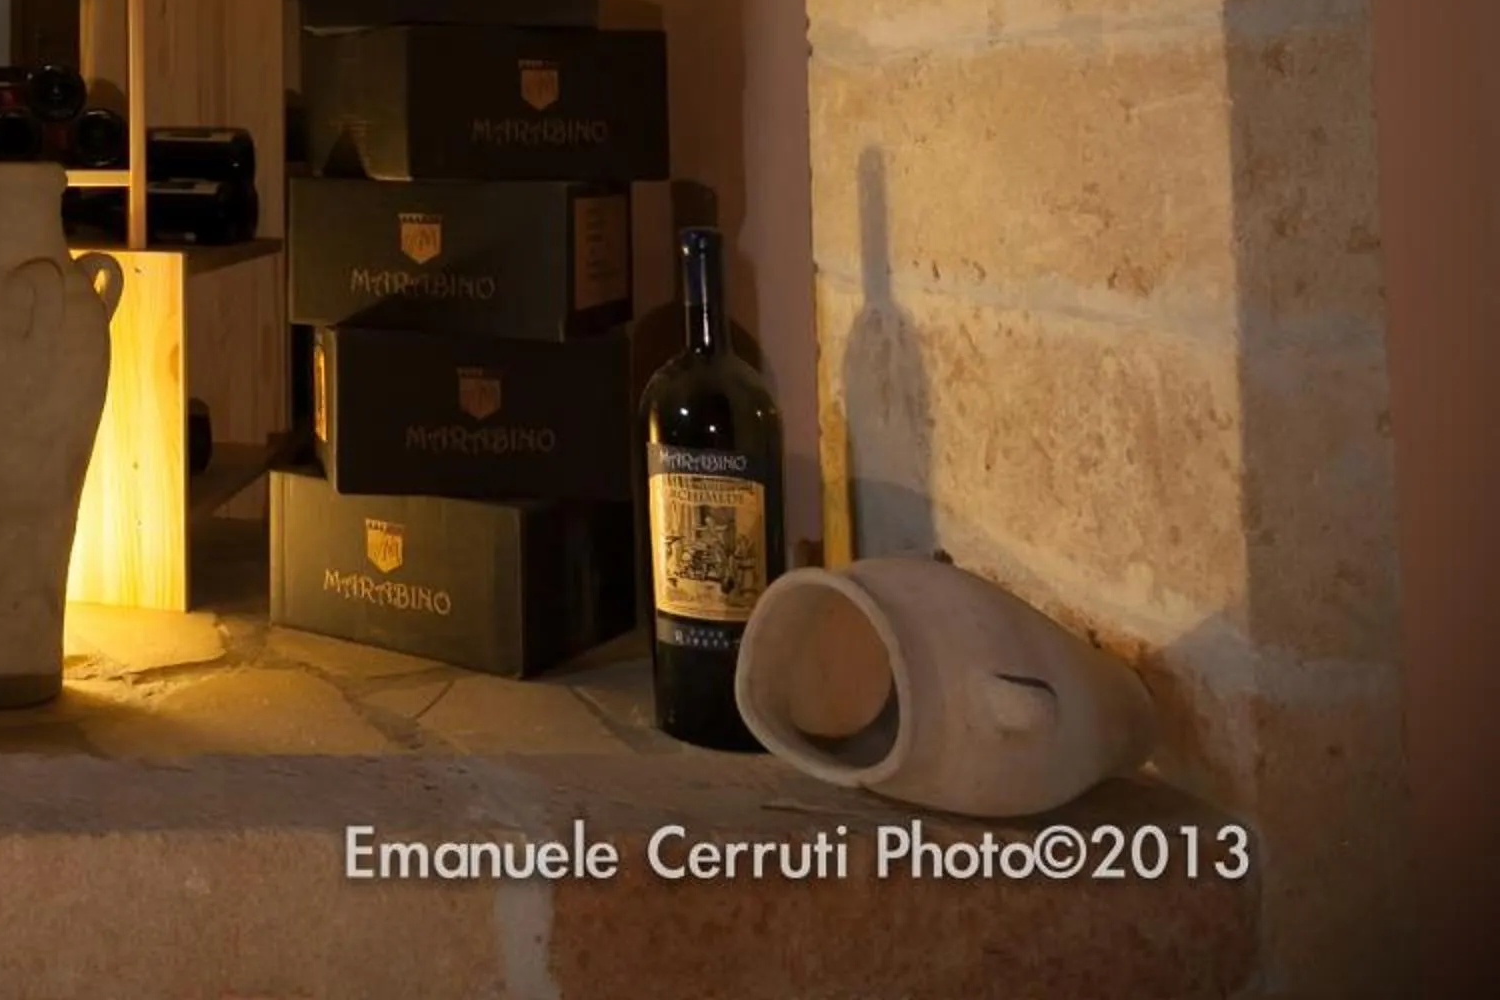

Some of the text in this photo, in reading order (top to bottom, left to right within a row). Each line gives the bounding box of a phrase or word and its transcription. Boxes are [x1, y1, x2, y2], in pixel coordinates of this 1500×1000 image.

[472, 120, 609, 145] MARABINO
[350, 268, 497, 301] MARABINO
[406, 424, 556, 455] MARABINO
[323, 569, 452, 616] MARABINO
